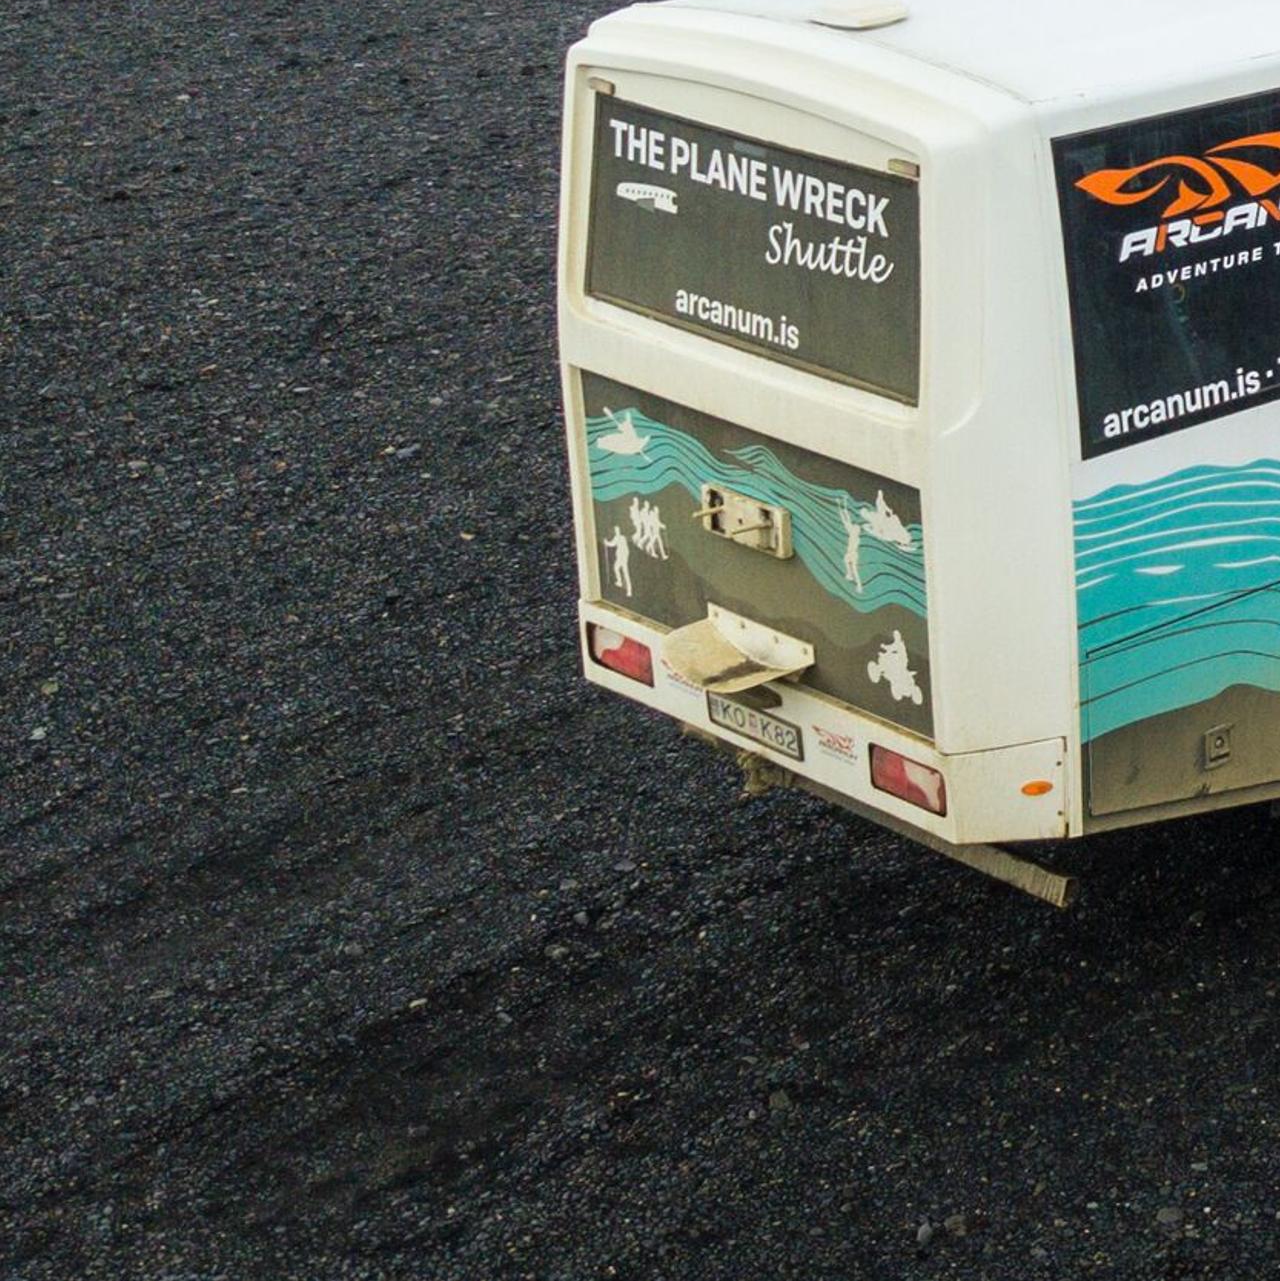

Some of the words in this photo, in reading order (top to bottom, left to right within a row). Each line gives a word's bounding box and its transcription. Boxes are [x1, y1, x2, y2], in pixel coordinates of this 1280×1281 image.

[610, 119, 665, 171] THE
[670, 136, 767, 201] PLANE
[772, 166, 891, 238] WRECK
[764, 221, 895, 283] Shuttle
[1135, 247, 1264, 293] ADVENTURE
[675, 288, 800, 350] arcanum.is
[1103, 367, 1261, 439] arcanum.is
